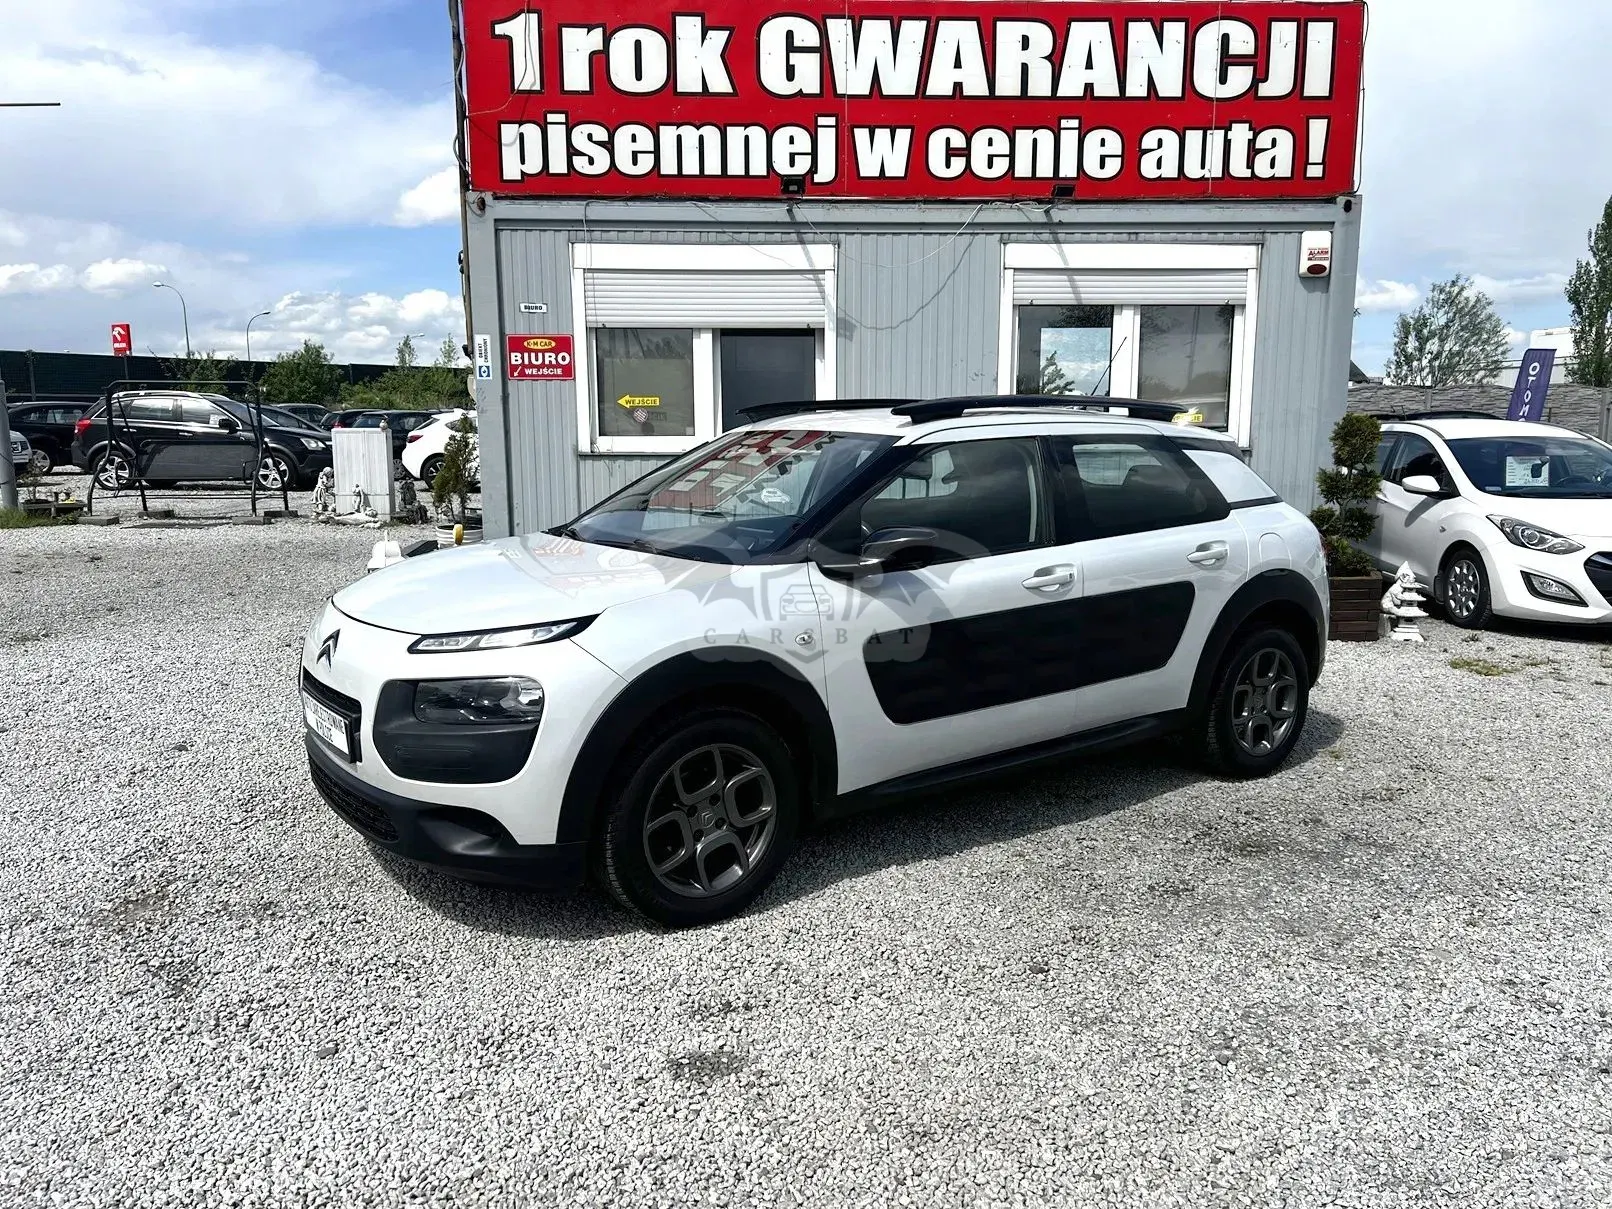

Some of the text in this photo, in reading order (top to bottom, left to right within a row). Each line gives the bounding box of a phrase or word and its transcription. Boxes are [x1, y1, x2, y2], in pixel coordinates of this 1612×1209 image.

[493, 11, 1334, 98] 1 rok GWARANCJI
[500, 113, 837, 184] pisemnej
[853, 127, 912, 178] w
[927, 118, 1122, 179] cenie
[1139, 122, 1295, 179] auta
[510, 352, 570, 366] BIURO
[539, 340, 553, 348] CAR
[524, 366, 563, 375] WEJŚCIE
[1518, 361, 1541, 422] OTOM
